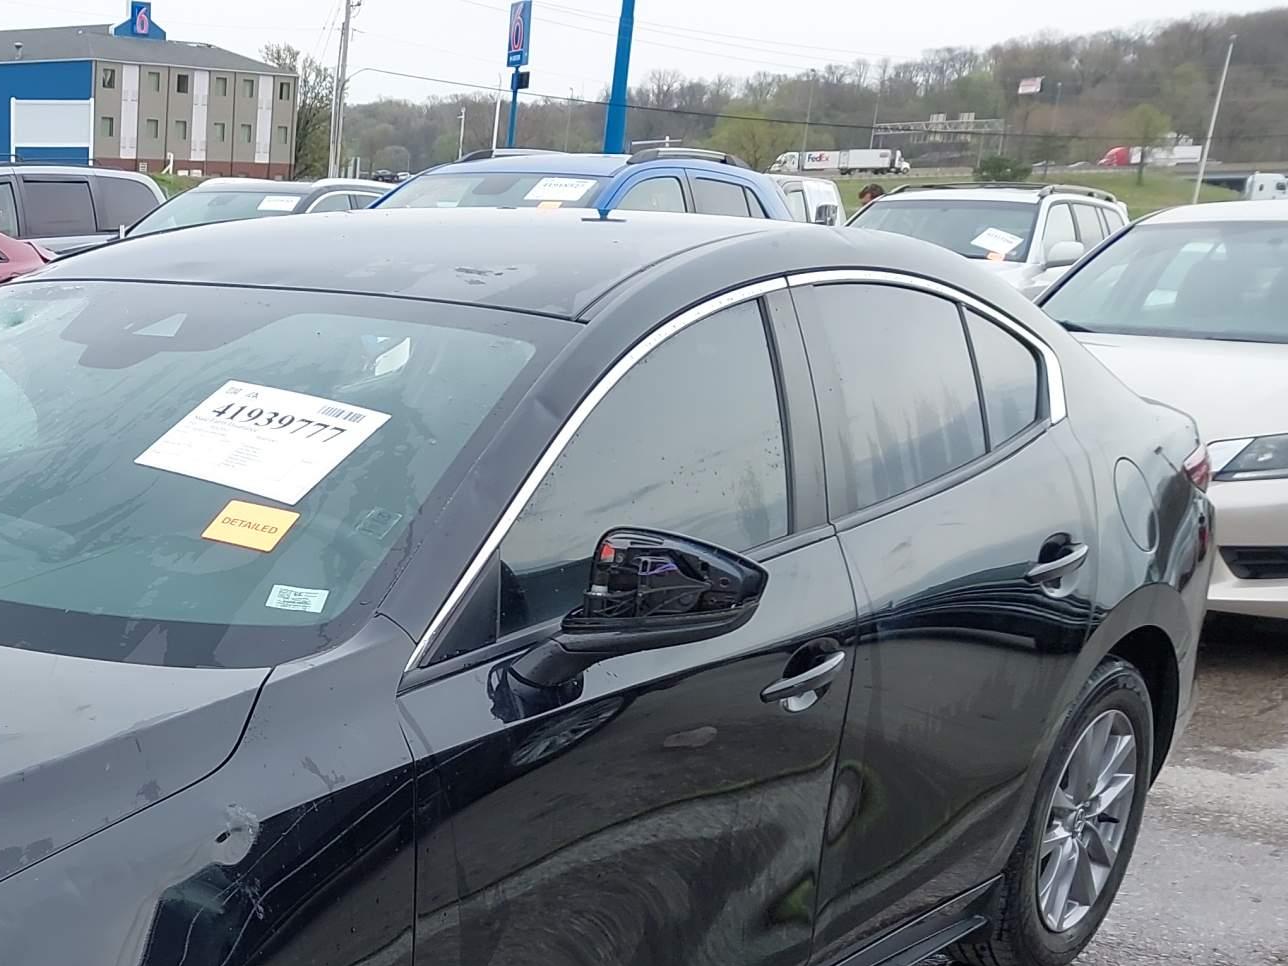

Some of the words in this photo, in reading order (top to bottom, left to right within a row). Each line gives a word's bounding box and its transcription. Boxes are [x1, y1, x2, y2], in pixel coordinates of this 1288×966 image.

[136, 7, 149, 34] 6
[511, 2, 524, 51] 6
[807, 153, 830, 162] FedEx
[212, 402, 347, 443] 41939777
[221, 516, 279, 534] DETAILED
